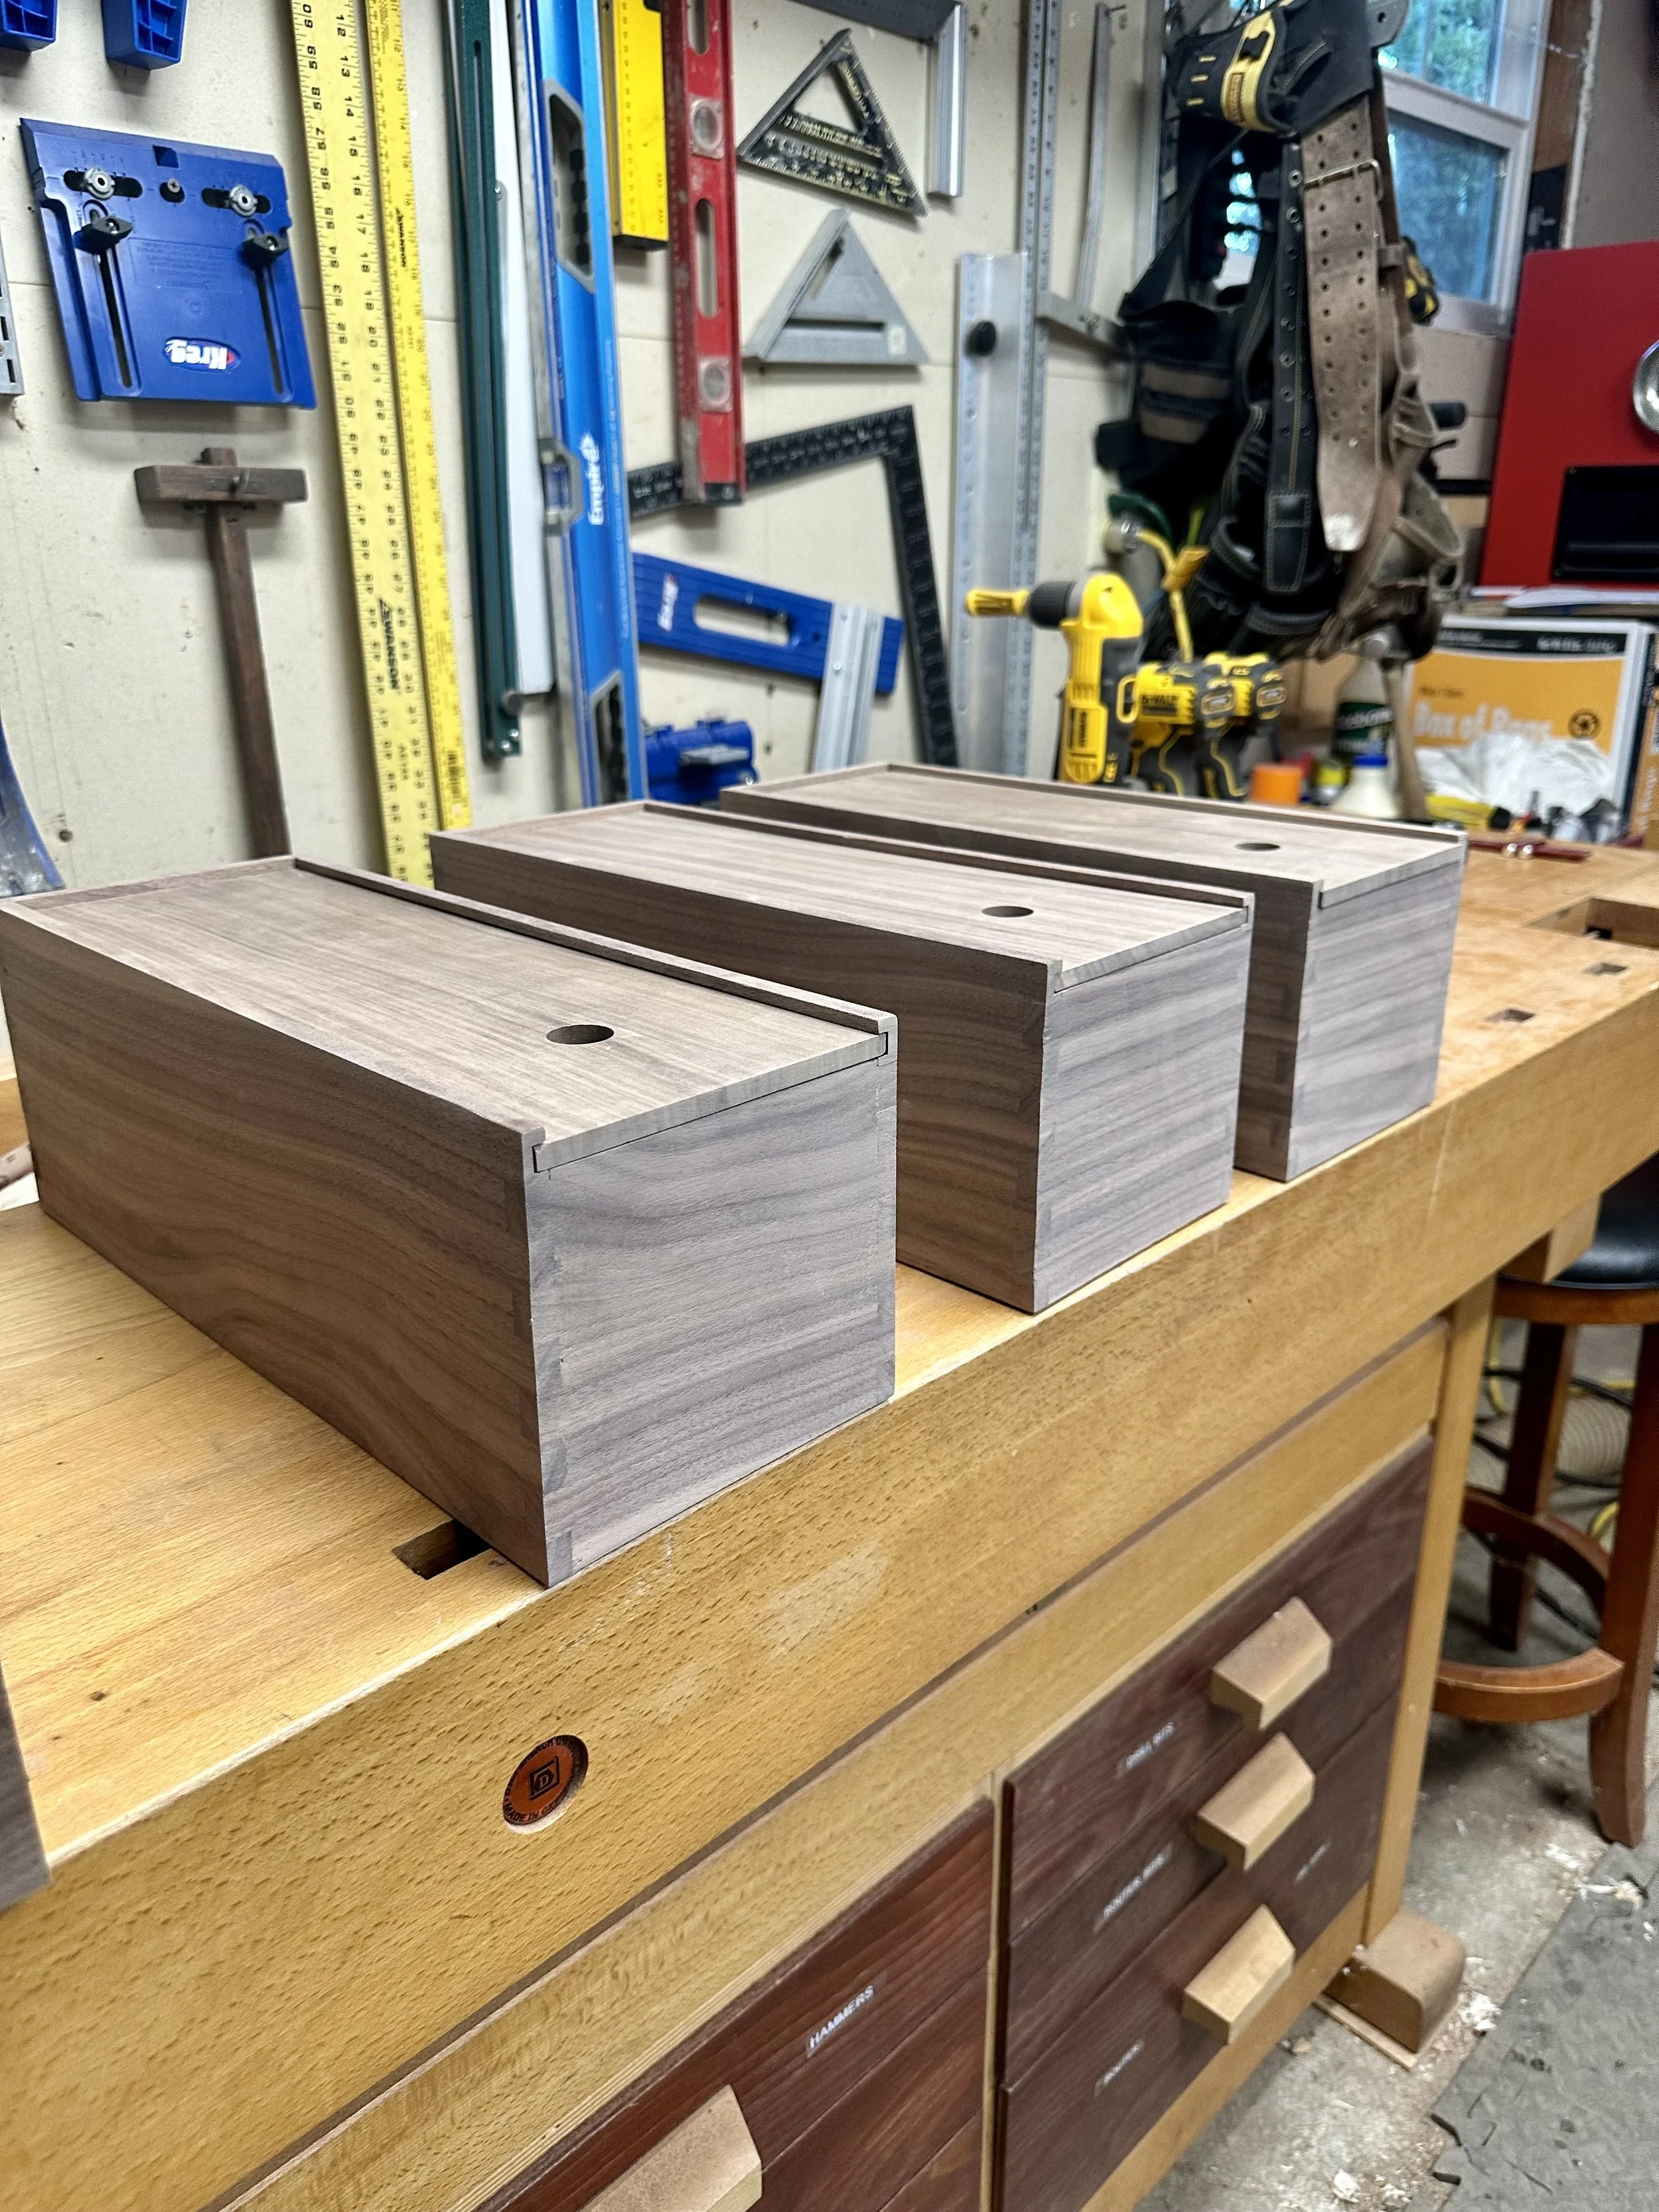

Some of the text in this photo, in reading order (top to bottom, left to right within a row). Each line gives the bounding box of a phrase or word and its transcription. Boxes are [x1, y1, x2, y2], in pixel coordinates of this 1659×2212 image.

[303, 4, 313, 28] 60
[336, 14, 346, 37] 12
[307, 46, 317, 69] 59
[340, 55, 350, 77] 13
[312, 87, 322, 110] 58
[344, 96, 354, 117] 14
[316, 127, 326, 150] 57
[348, 136, 358, 157] 15
[321, 167, 330, 190] 56
[352, 176, 362, 196] 16
[325, 207, 334, 229] 55
[356, 214, 366, 234] 17
[329, 246, 339, 268] 54
[360, 253, 370, 272] 18
[333, 285, 343, 306] 53
[364, 291, 374, 310] 19
[337, 323, 347, 344] 52
[368, 327, 378, 347] 20
[165, 339, 228, 369] Kreg
[340, 361, 352, 382] 51
[344, 397, 355, 418] 50
[584, 443, 604, 525] Empire
[380, 607, 398, 689] SWANSON
[1414, 701, 1455, 738] Box
[504, 1804, 526, 1823] MADE
[527, 1810, 539, 1822] IN
[810, 1985, 874, 2049] HAMMERS
